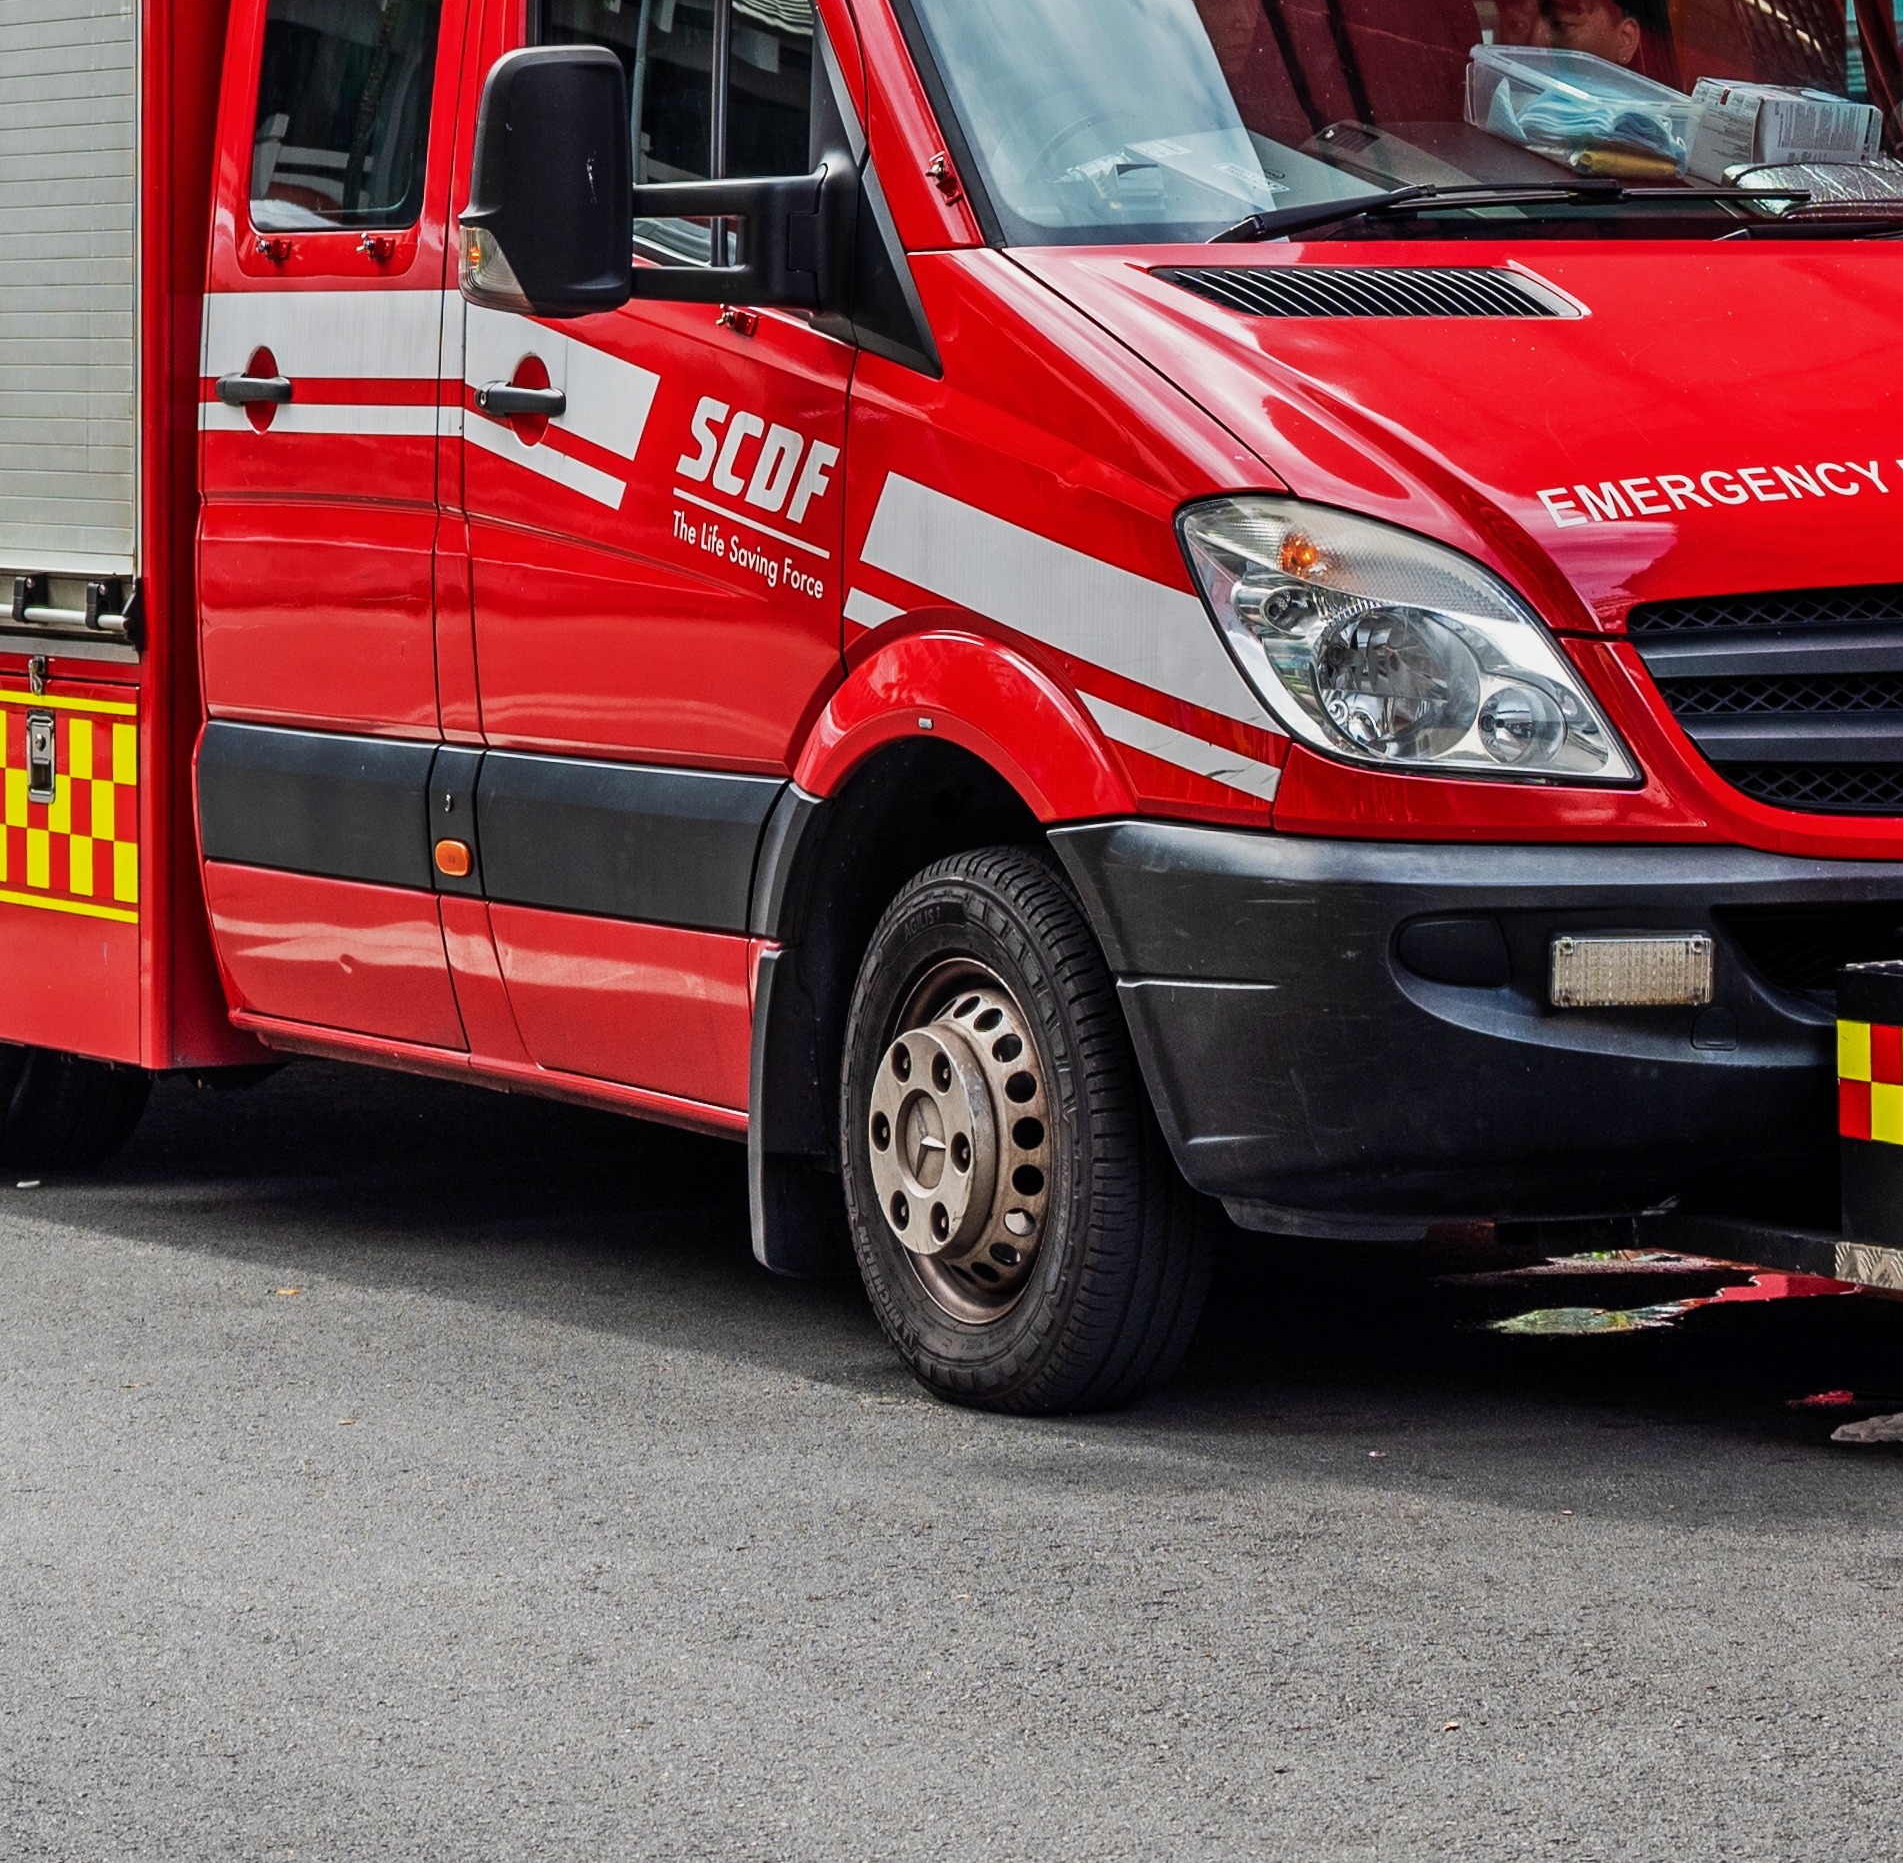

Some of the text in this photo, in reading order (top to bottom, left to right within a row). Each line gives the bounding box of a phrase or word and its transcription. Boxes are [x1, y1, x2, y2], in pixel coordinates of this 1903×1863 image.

[675, 395, 841, 524] SCDF
[1536, 460, 1890, 530] EMERGENCY
[673, 510, 824, 599] The Life Saving Force
[858, 1226, 904, 1328] MICHELIN
